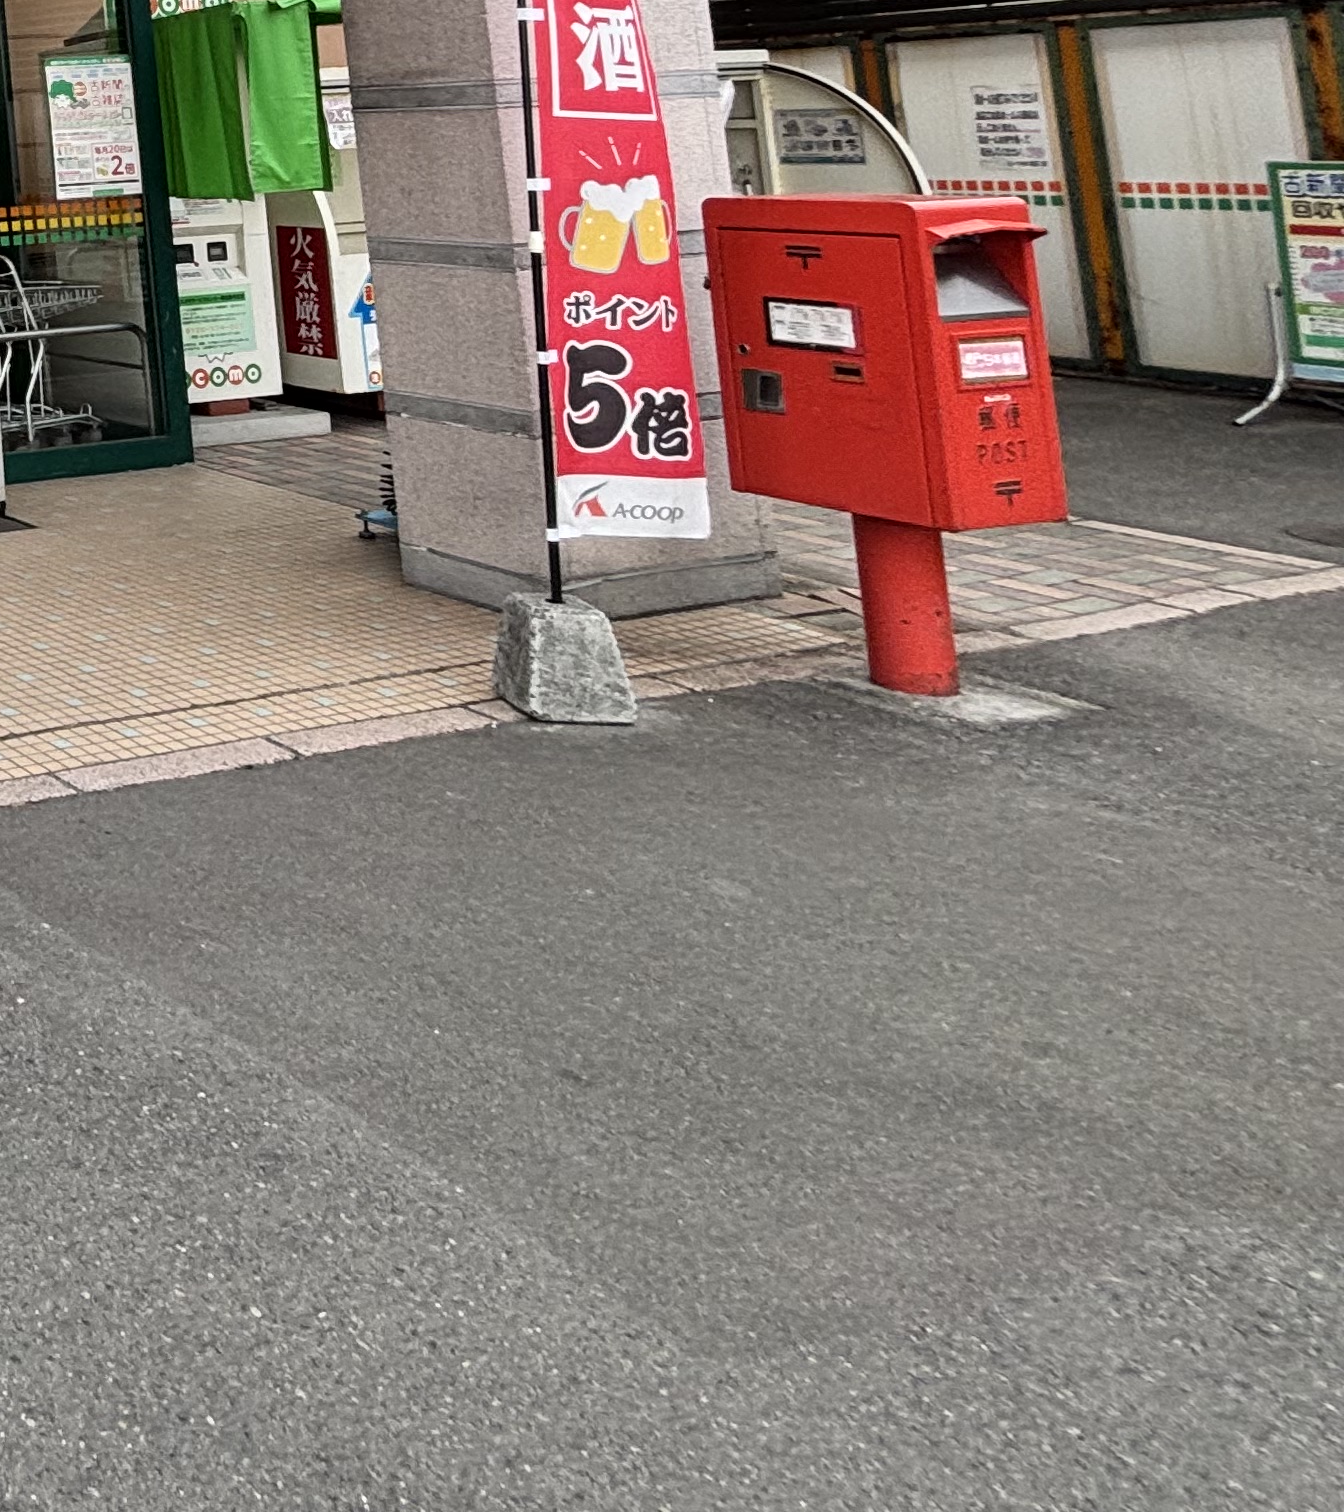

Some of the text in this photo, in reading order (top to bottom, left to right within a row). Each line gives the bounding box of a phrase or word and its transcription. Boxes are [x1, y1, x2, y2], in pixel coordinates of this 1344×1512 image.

[289, 227, 324, 355] 火気厳禁
[564, 292, 678, 331] ポイント
[565, 344, 691, 459] 5倍
[976, 439, 1028, 464] POST
[612, 499, 685, 524] A-COOP
